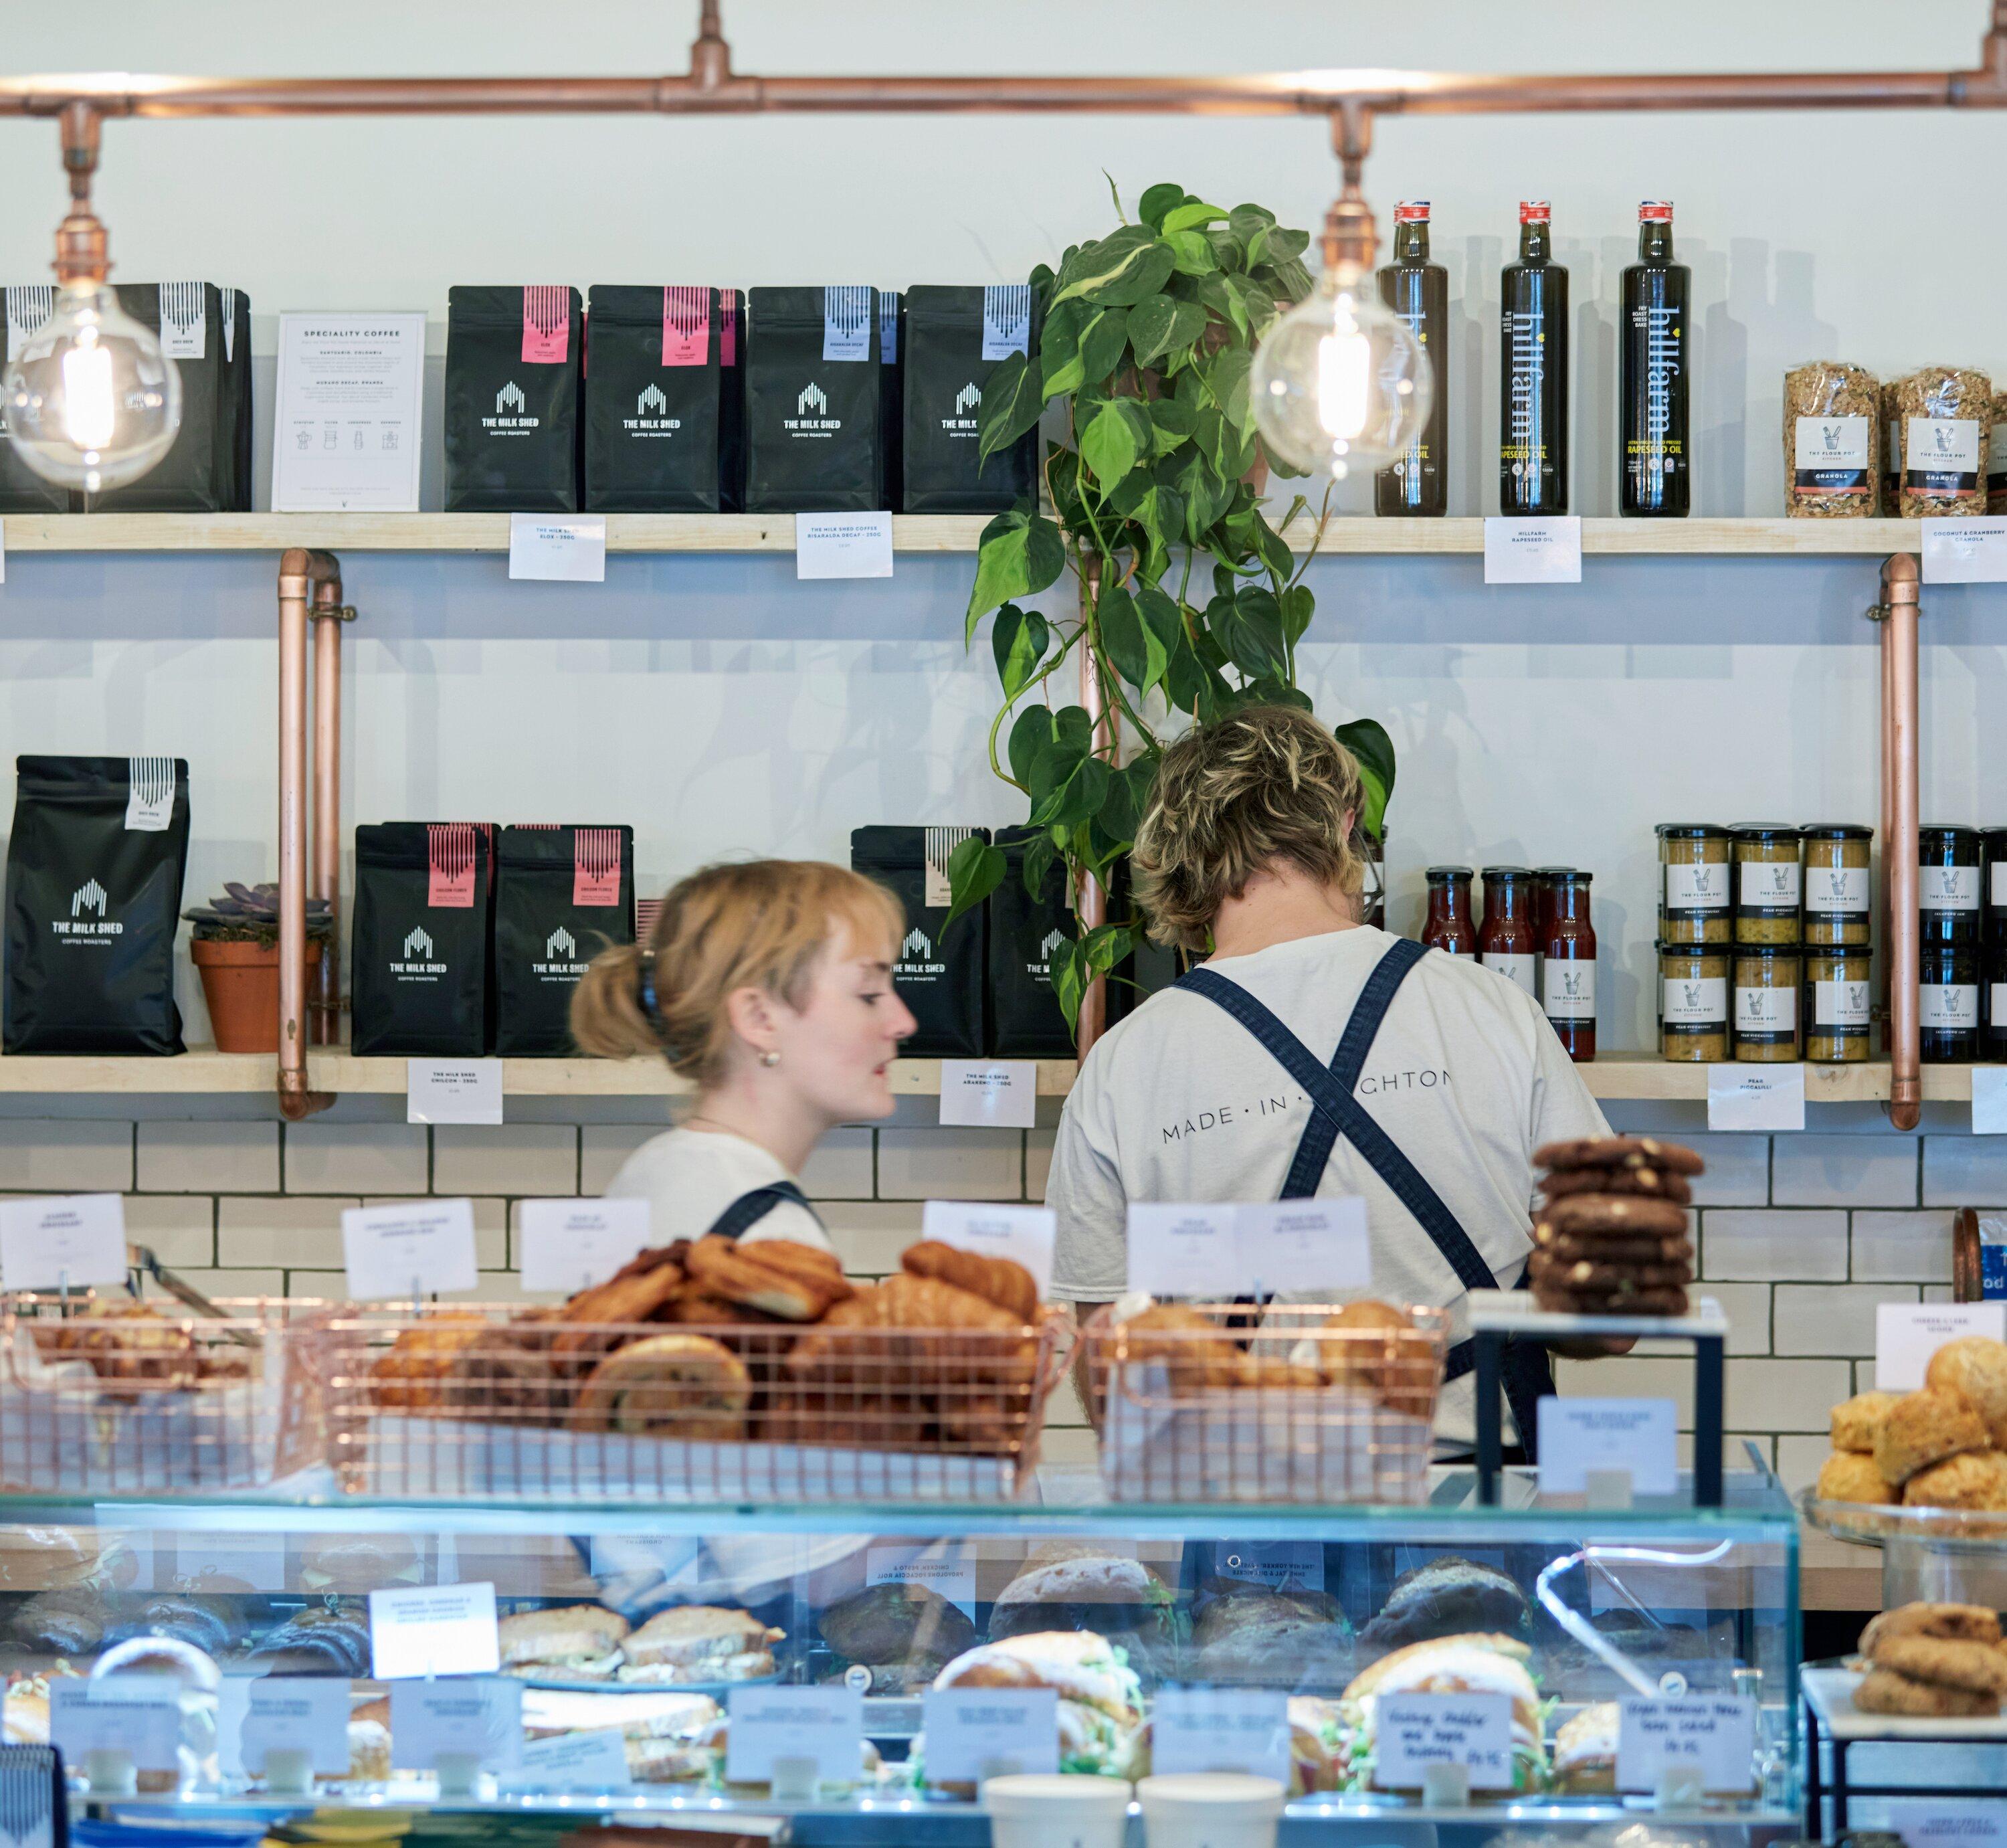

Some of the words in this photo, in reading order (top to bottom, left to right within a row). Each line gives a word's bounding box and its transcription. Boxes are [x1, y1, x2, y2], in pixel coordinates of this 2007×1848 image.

[1648, 306, 1680, 433] hillfarm
[1511, 310, 1544, 440] hillfarm
[482, 418, 496, 427] THE
[498, 418, 517, 427] MILK
[518, 418, 539, 427] SHED
[624, 420, 638, 429] THE
[640, 420, 659, 429] MILK
[660, 420, 680, 429] SHED
[784, 420, 799, 429] THE
[800, 420, 819, 429] MILK
[820, 420, 841, 429] SHED
[941, 420, 957, 429] THE
[958, 420, 977, 429] MILK
[1628, 446, 1668, 454] RAPESEED
[1669, 446, 1682, 454] OIL
[53, 921, 70, 933] THE
[72, 922, 96, 934] MILK
[98, 922, 123, 934] SHED
[390, 963, 404, 972] THE
[405, 963, 425, 973] MILK
[426, 963, 447, 973] SHED
[533, 963, 547, 973] THE
[549, 963, 568, 973] MILK
[569, 963, 589, 973] SHED
[904, 964, 923, 973] MILK
[924, 964, 945, 973] SHED
[1027, 964, 1041, 973] THE
[1163, 1106, 1234, 1143] MADE
[1260, 1096, 1286, 1115] IN
[1360, 1070, 1452, 1095] GHTON
